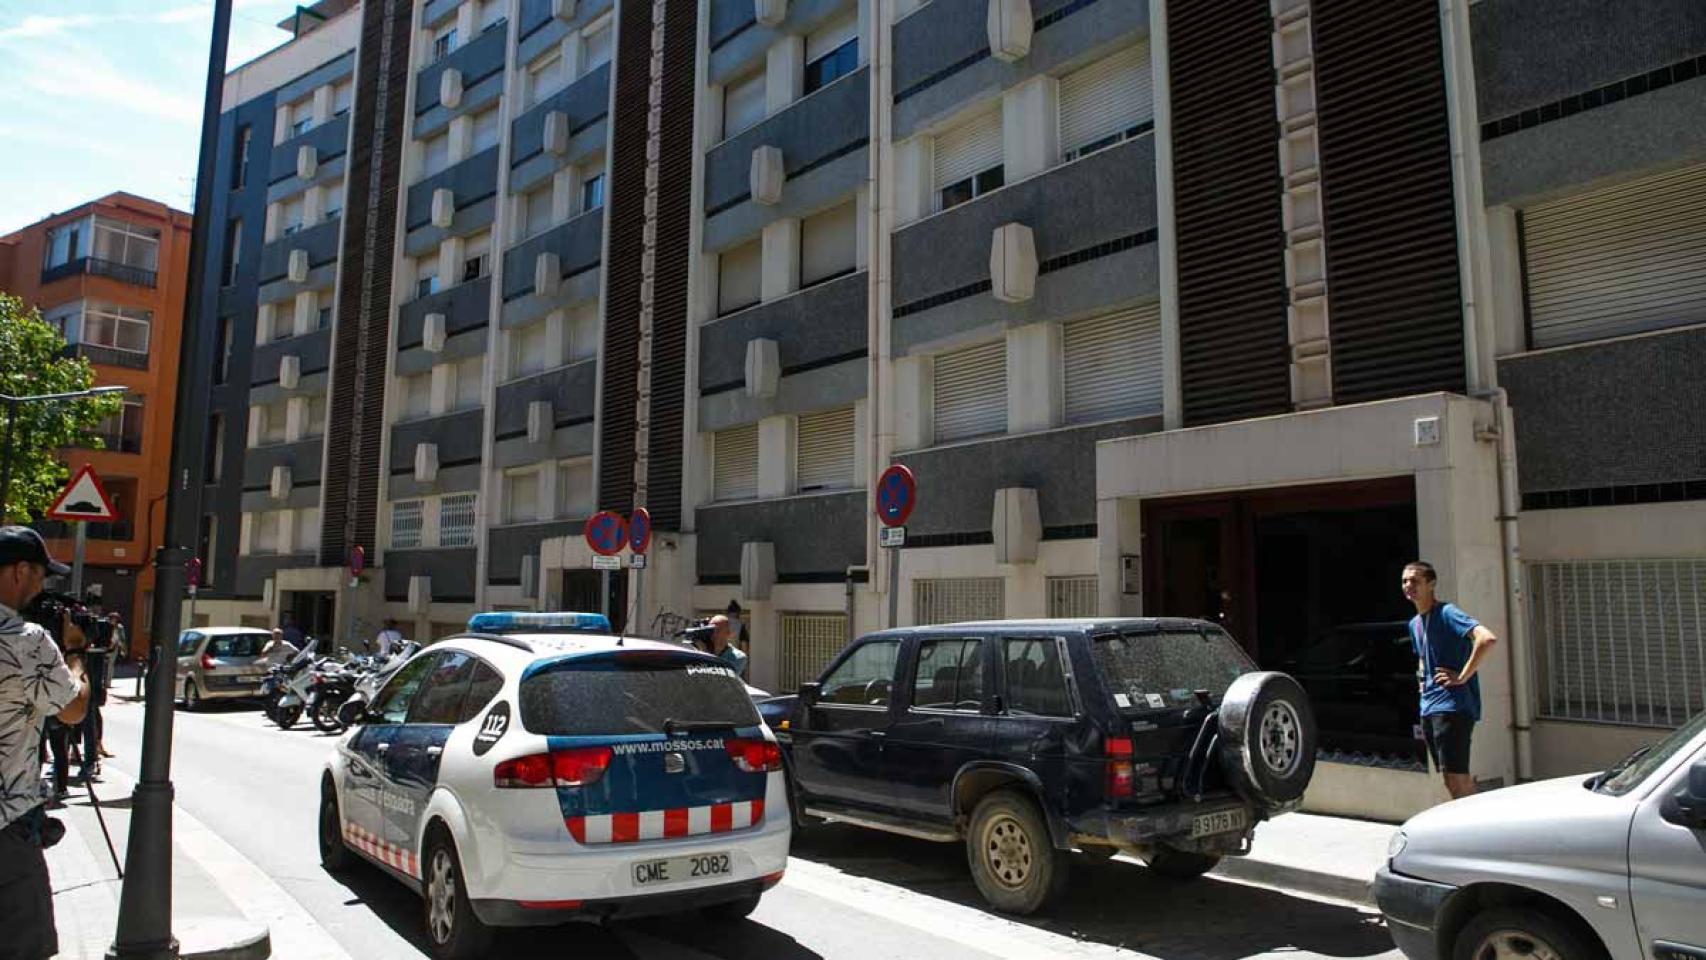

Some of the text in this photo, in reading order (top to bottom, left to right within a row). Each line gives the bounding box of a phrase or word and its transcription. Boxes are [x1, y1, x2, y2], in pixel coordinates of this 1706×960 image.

[482, 714, 507, 736] 112
[612, 738, 726, 755] www.mossos.cat
[635, 855, 729, 883] CME 2082
